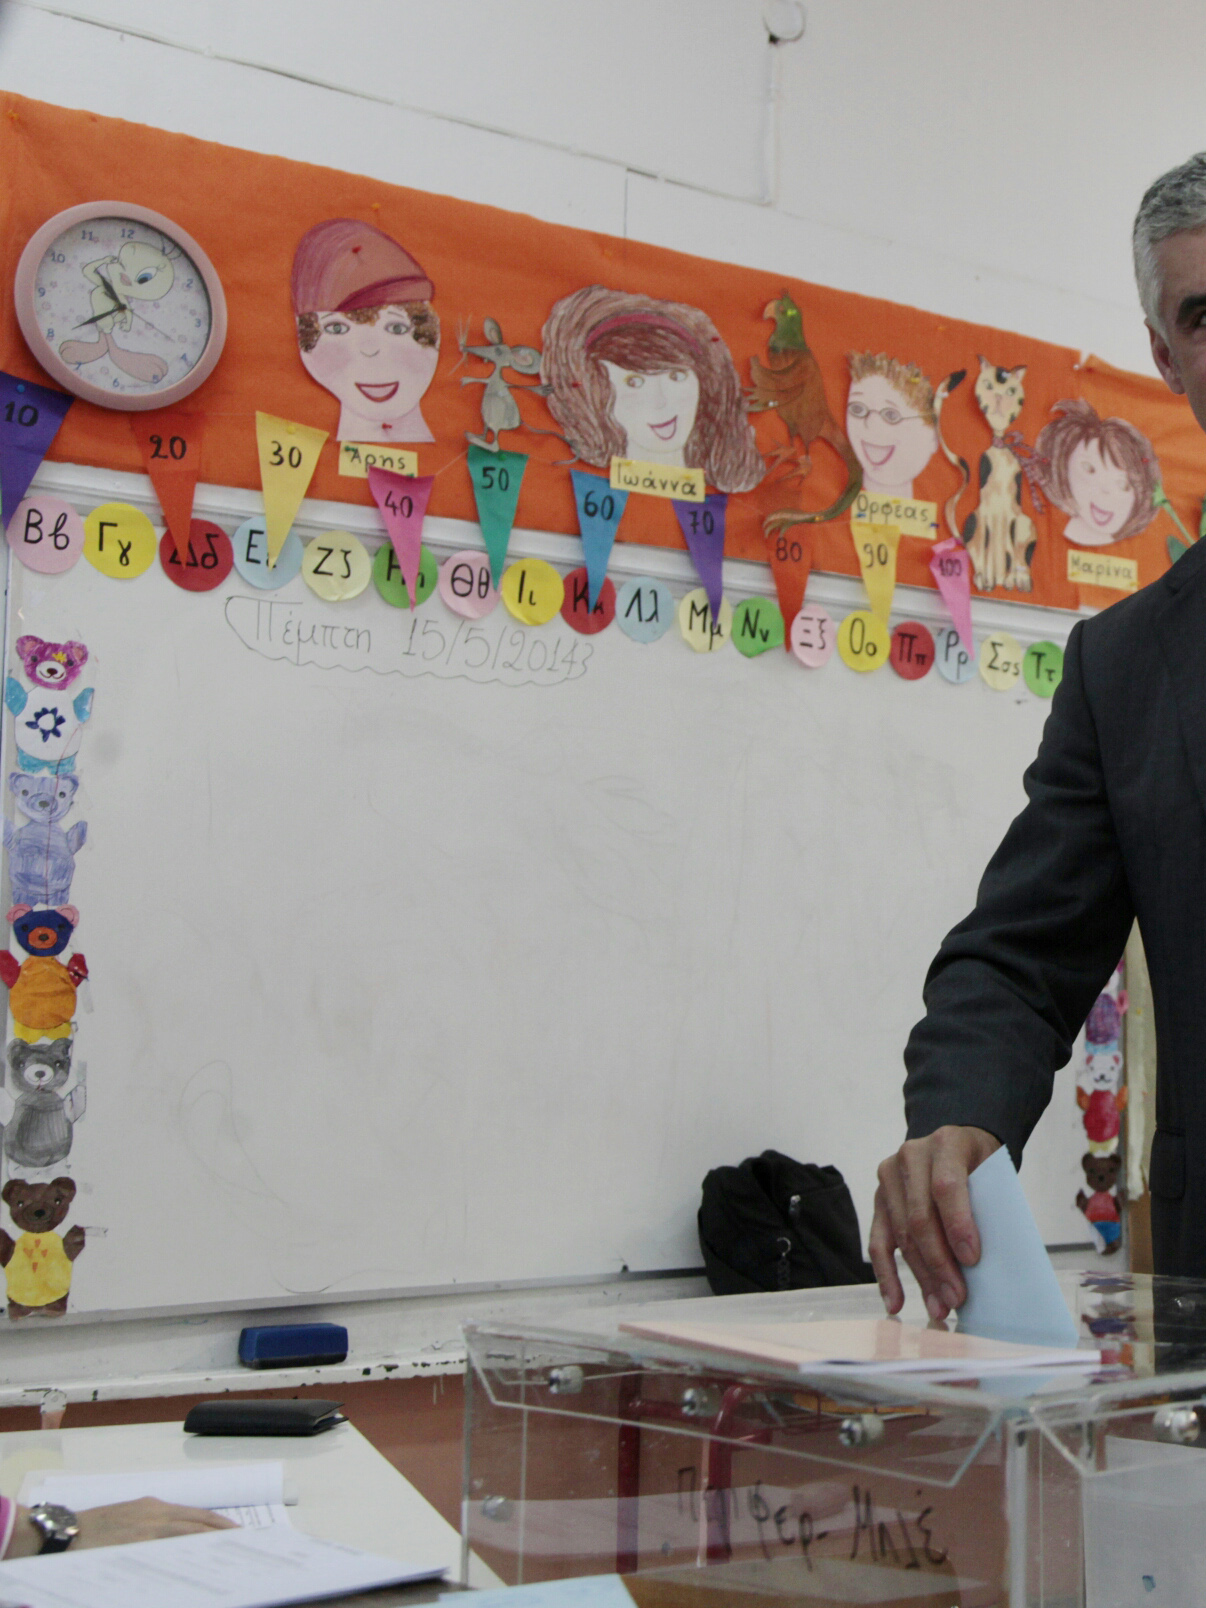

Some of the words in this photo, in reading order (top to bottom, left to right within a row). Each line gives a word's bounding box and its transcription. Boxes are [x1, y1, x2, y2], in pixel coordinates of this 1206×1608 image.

[81, 230, 94, 241] 11
[120, 228, 135, 239] 12
[50, 252, 66, 263] 10
[37, 287, 46, 297] 9
[186, 279, 194, 289] 2
[46, 328, 55, 338] 8
[195, 319, 201, 328] 3
[112, 378, 120, 388] 6
[4, 401, 40, 427] 10
[149, 435, 188, 460] 20
[268, 440, 303, 468] 30
[481, 466, 510, 492] 50
[617, 462, 698, 497] Ιωάννα
[383, 491, 414, 518] 40
[582, 490, 615, 521] 60
[688, 510, 715, 535] 70
[98, 521, 132, 567] Γγ
[775, 536, 803, 563] 80
[862, 542, 889, 569] 90
[312, 546, 352, 579] Ζζ
[938, 557, 963, 577] 100
[450, 563, 491, 599] Θθ
[517, 570, 537, 606] Ιι
[624, 587, 660, 623] Λλ
[246, 597, 372, 665] Πέμπτη
[402, 617, 579, 675] 15/5/2014
[741, 608, 770, 642] Νν
[799, 615, 828, 650] Ξξ
[849, 617, 878, 657] Οο
[897, 632, 928, 666] Ππ
[944, 630, 968, 680] Ρρ
[1031, 651, 1056, 682] Ττ
